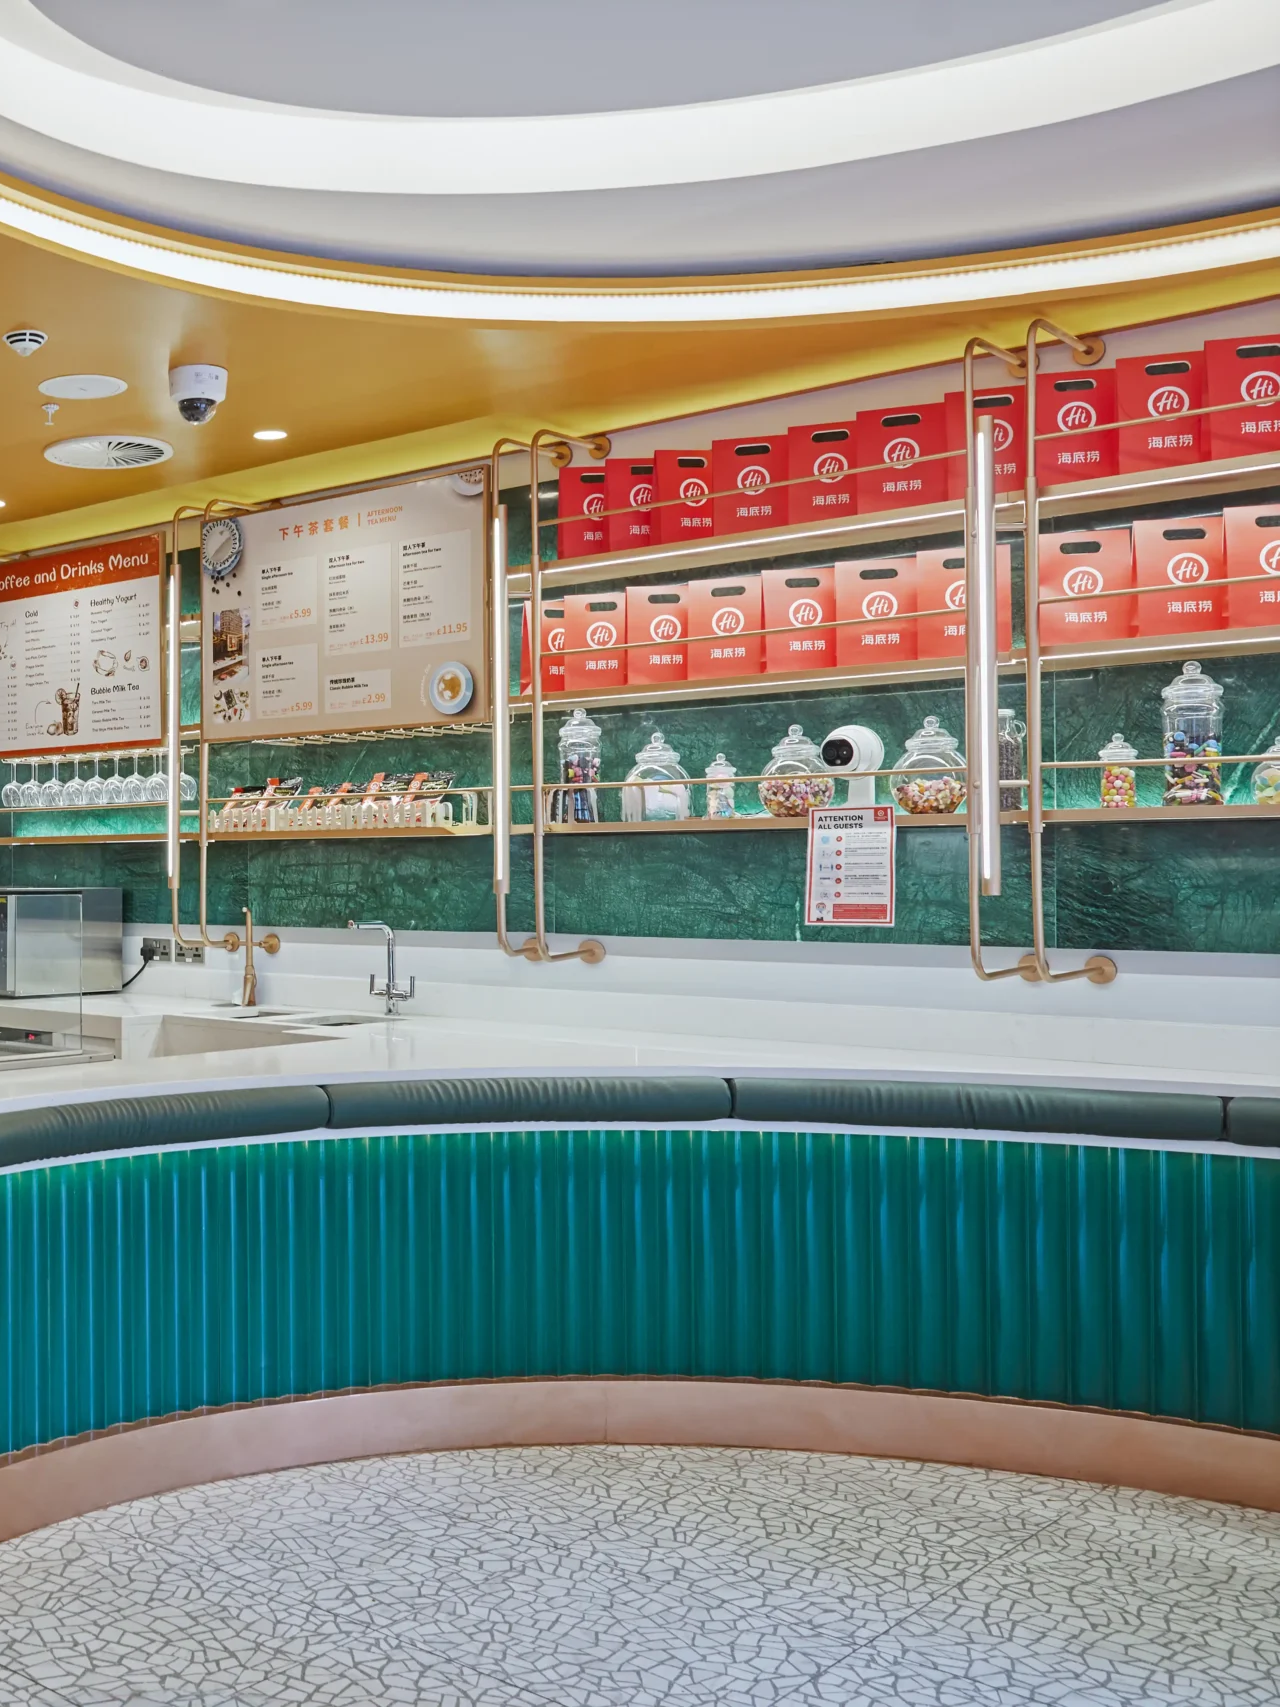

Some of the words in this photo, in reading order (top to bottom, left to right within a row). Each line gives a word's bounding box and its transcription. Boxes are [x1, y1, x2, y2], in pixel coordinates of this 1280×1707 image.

[1250, 378, 1275, 399] Hi
[1157, 391, 1180, 412] Hi
[1066, 407, 1088, 426] Hi
[1148, 434, 1193, 449] 海底捞
[891, 444, 911, 460] Hi
[1057, 451, 1100, 465] 海底捞
[821, 459, 840, 475] Hi
[744, 472, 762, 487] Hi
[882, 479, 922, 493] 海底捞
[686, 484, 701, 498] Hi
[812, 493, 850, 506] 海底捞
[367, 505, 403, 518] AFTERNOON
[736, 505, 772, 518] 海底捞
[379, 515, 397, 523] MENU
[680, 517, 712, 528] 海底捞
[279, 515, 349, 540] 下午茶套餐
[629, 525, 651, 535] 海底
[583, 531, 603, 541] 海底
[34, 567, 57, 585] and
[60, 560, 105, 580] Drinks
[108, 553, 149, 571] Menu
[1176, 559, 1200, 580] Hi
[1072, 573, 1095, 593] Hi
[90, 597, 114, 607] Healthy
[115, 593, 137, 604] Yogurt
[870, 597, 890, 616] Hi
[1167, 600, 1213, 614] 海底捞
[25, 610, 38, 618] Cold
[289, 608, 311, 619] £5.99
[796, 605, 815, 622] Hi
[1064, 611, 1107, 623] 海底捞
[437, 622, 468, 635] £11.95
[719, 613, 737, 630] Hi
[593, 627, 609, 643] Hi
[656, 620, 674, 638] Hi
[360, 632, 389, 645] £13.99
[789, 640, 826, 651] 海底捞
[861, 633, 900, 646] 海底捞
[649, 654, 683, 665] 海底捞
[710, 647, 746, 659] 海底捞
[585, 660, 619, 671] 海底捞
[90, 687, 111, 695] Bubble
[113, 685, 126, 693] Milk
[127, 683, 139, 691] Tea
[362, 693, 386, 704] £2.99
[291, 701, 313, 711] £5.99
